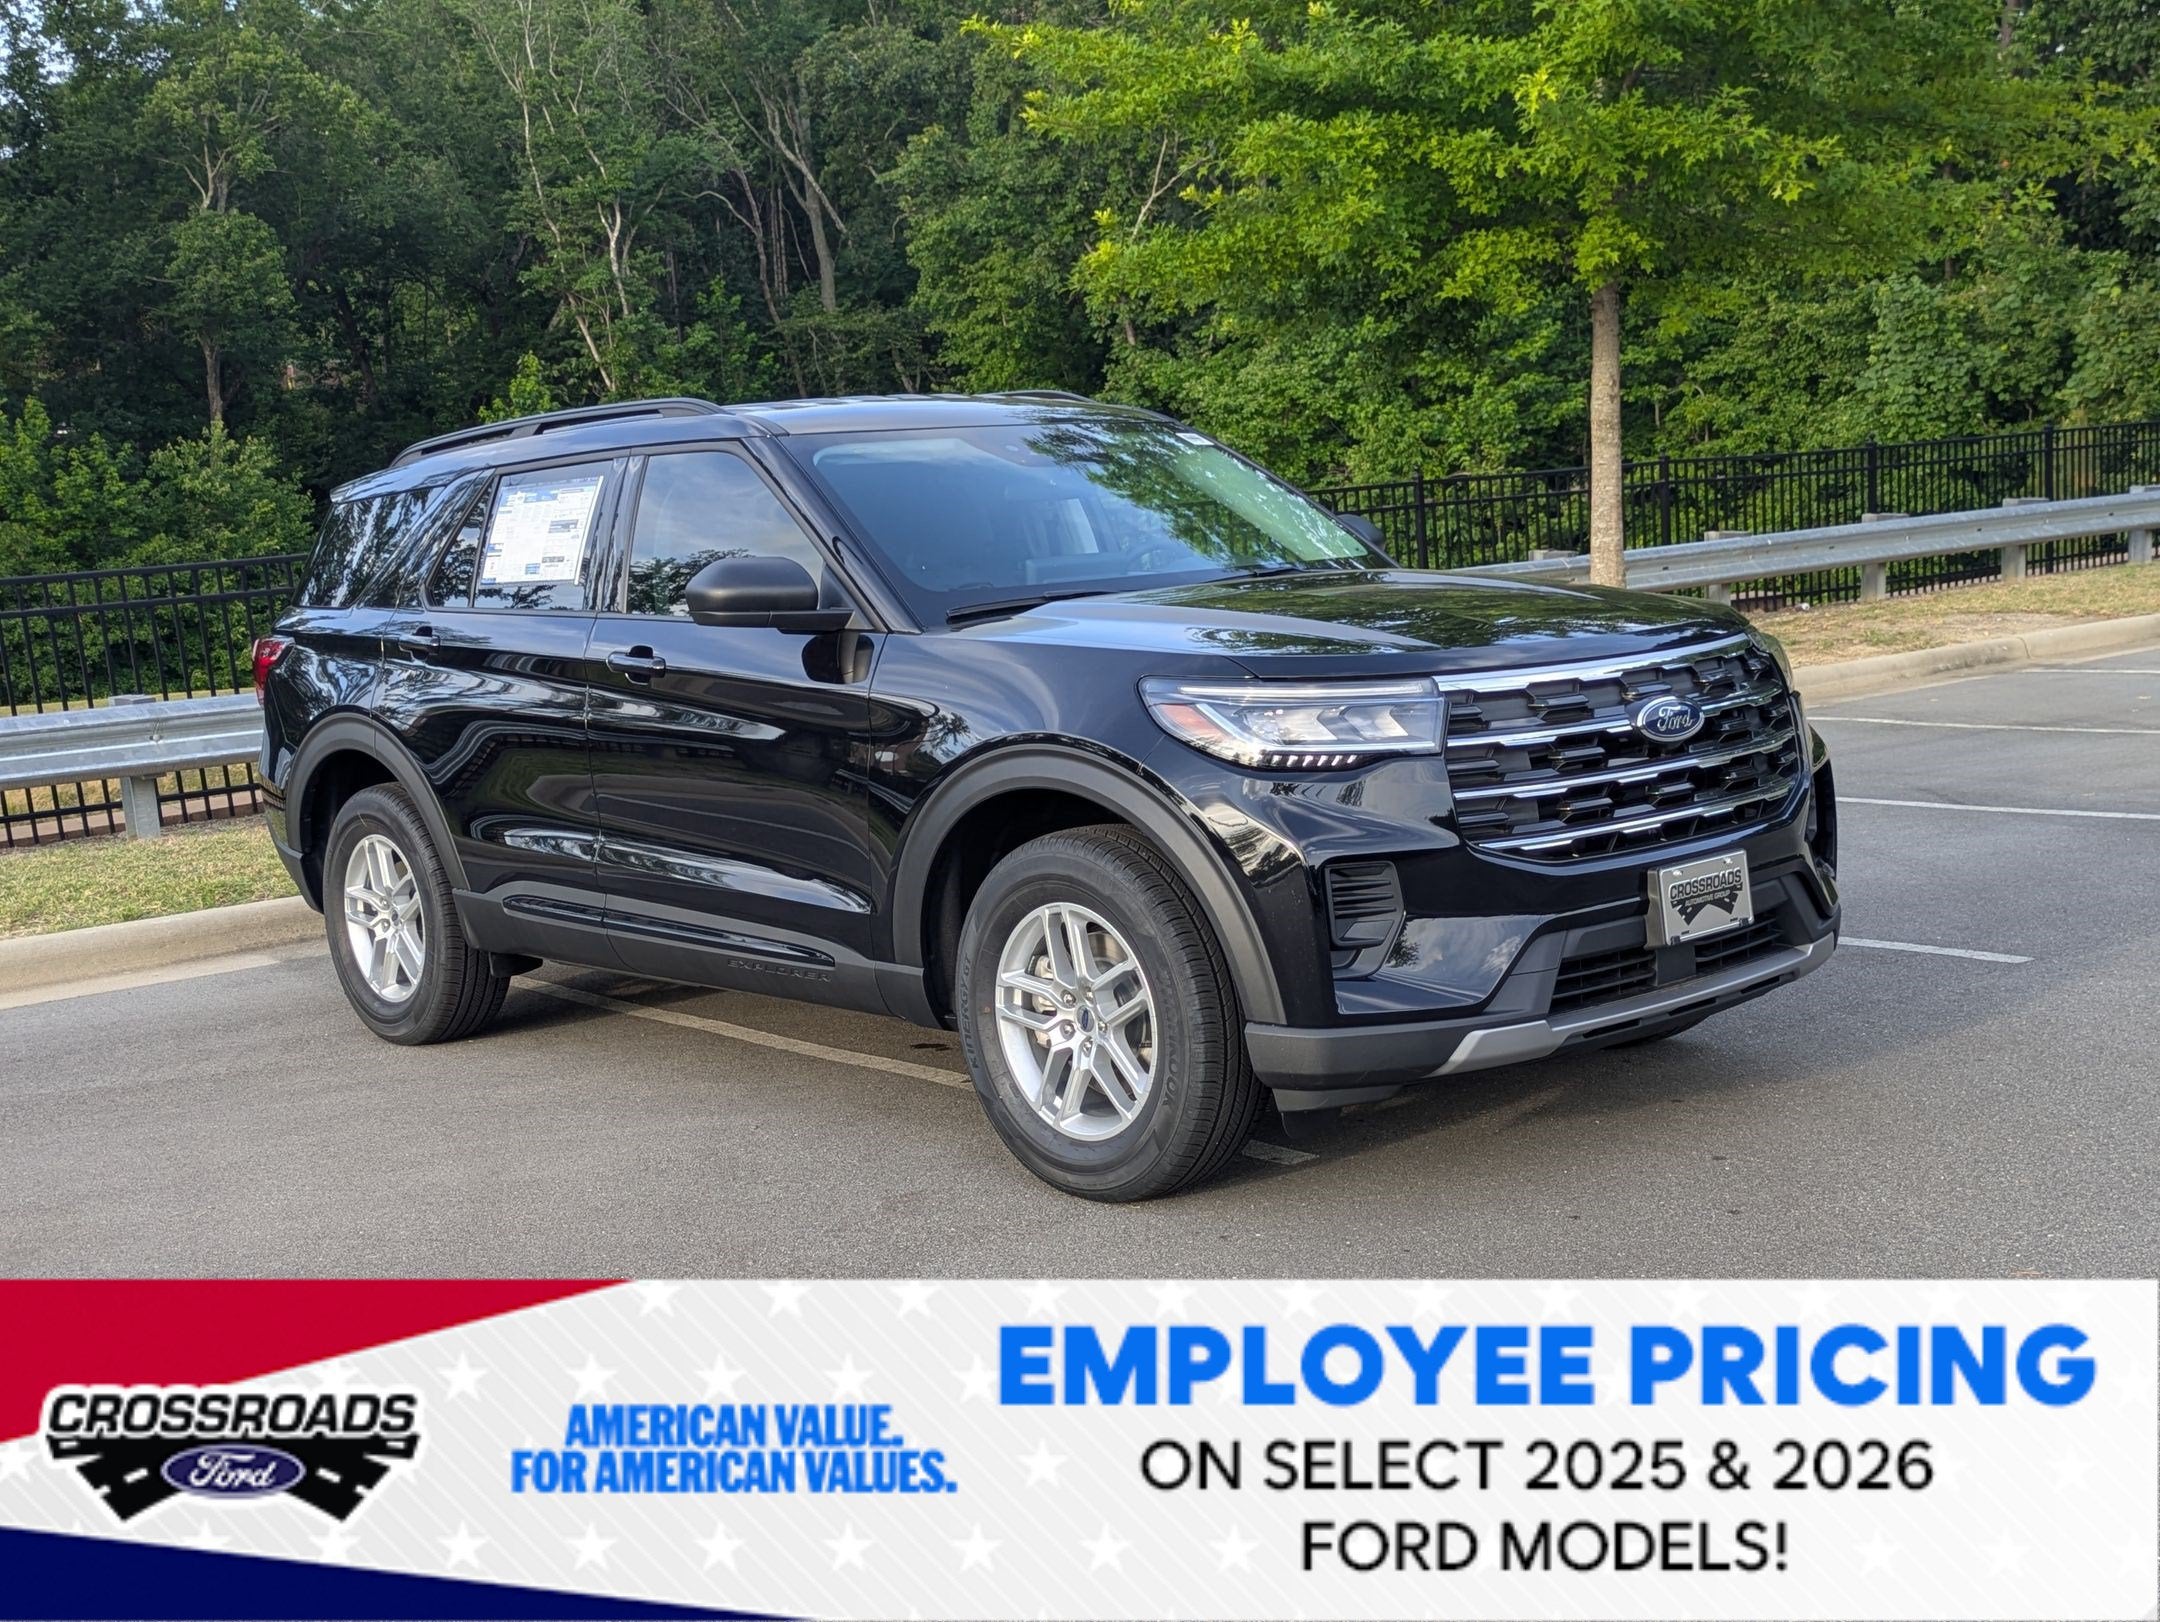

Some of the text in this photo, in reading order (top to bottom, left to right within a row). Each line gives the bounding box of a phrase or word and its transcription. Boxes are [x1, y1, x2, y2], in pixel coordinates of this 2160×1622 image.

[1657, 705, 1696, 731] Ford
[1669, 868, 1742, 900] CROSSROADS
[727, 959, 832, 982] EXPLORER
